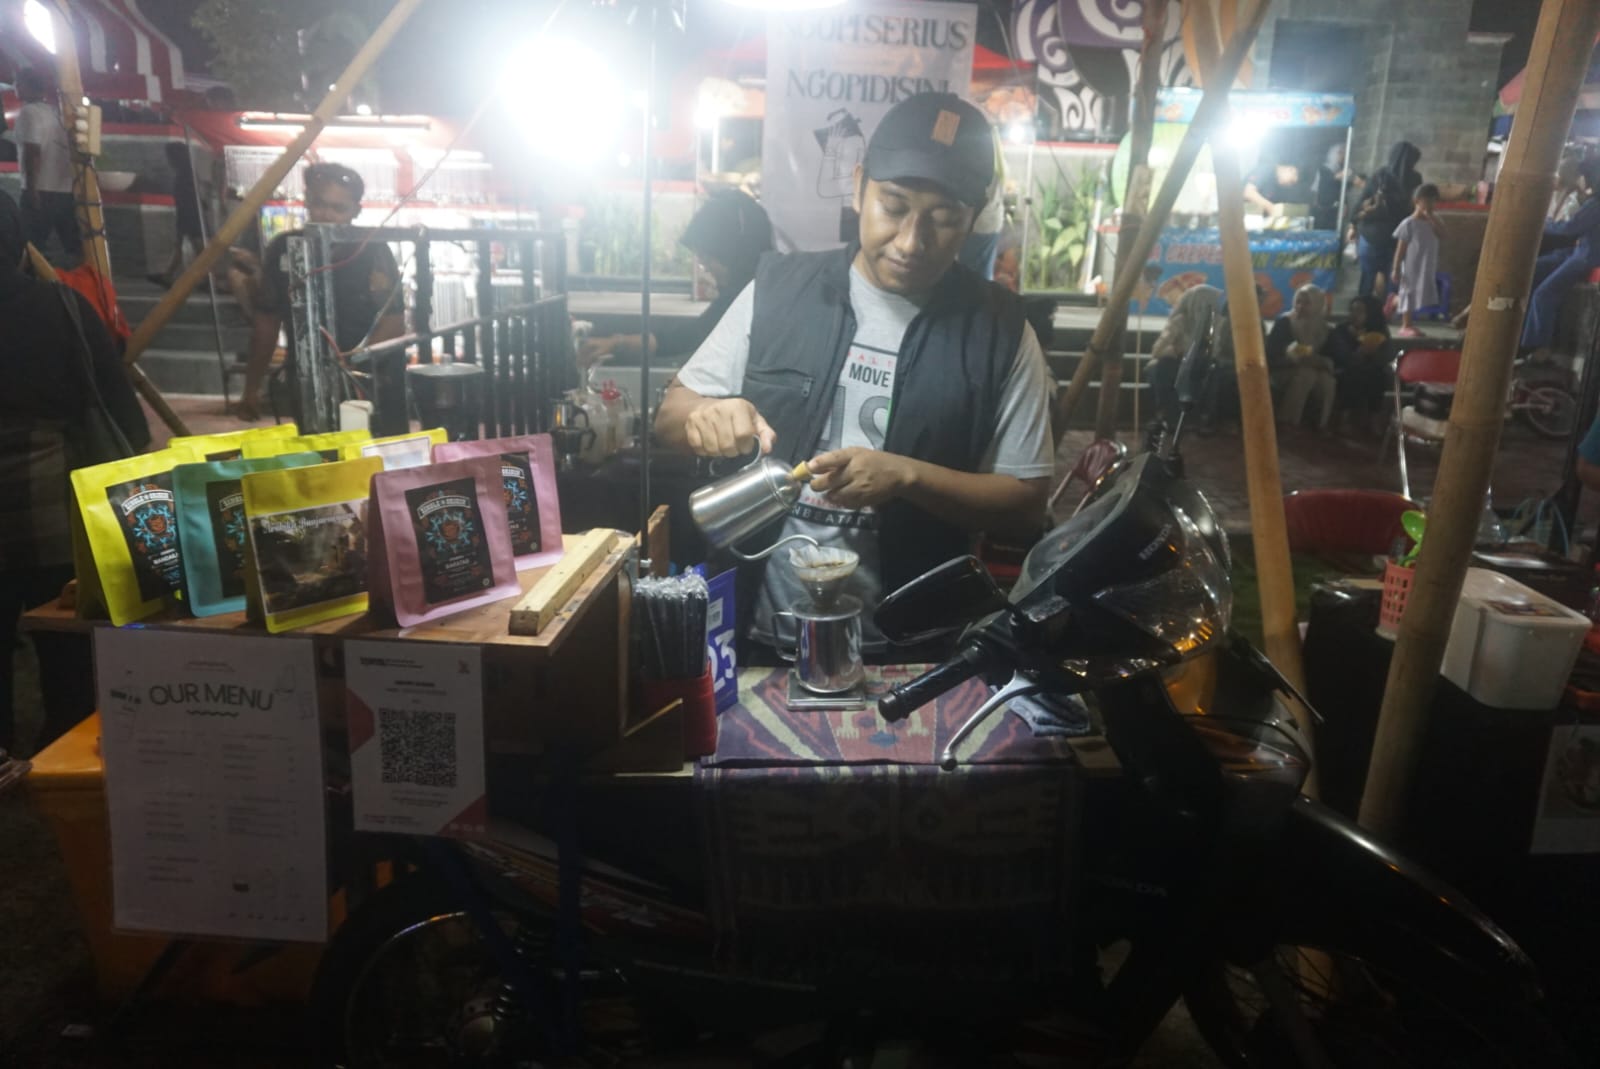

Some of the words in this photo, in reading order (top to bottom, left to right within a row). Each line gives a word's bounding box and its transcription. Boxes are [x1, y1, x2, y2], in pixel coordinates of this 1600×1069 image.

[863, 14, 968, 50] SERIUS
[848, 362, 891, 388] MOVE
[149, 683, 199, 706] OUR
[203, 683, 274, 711] MENU
